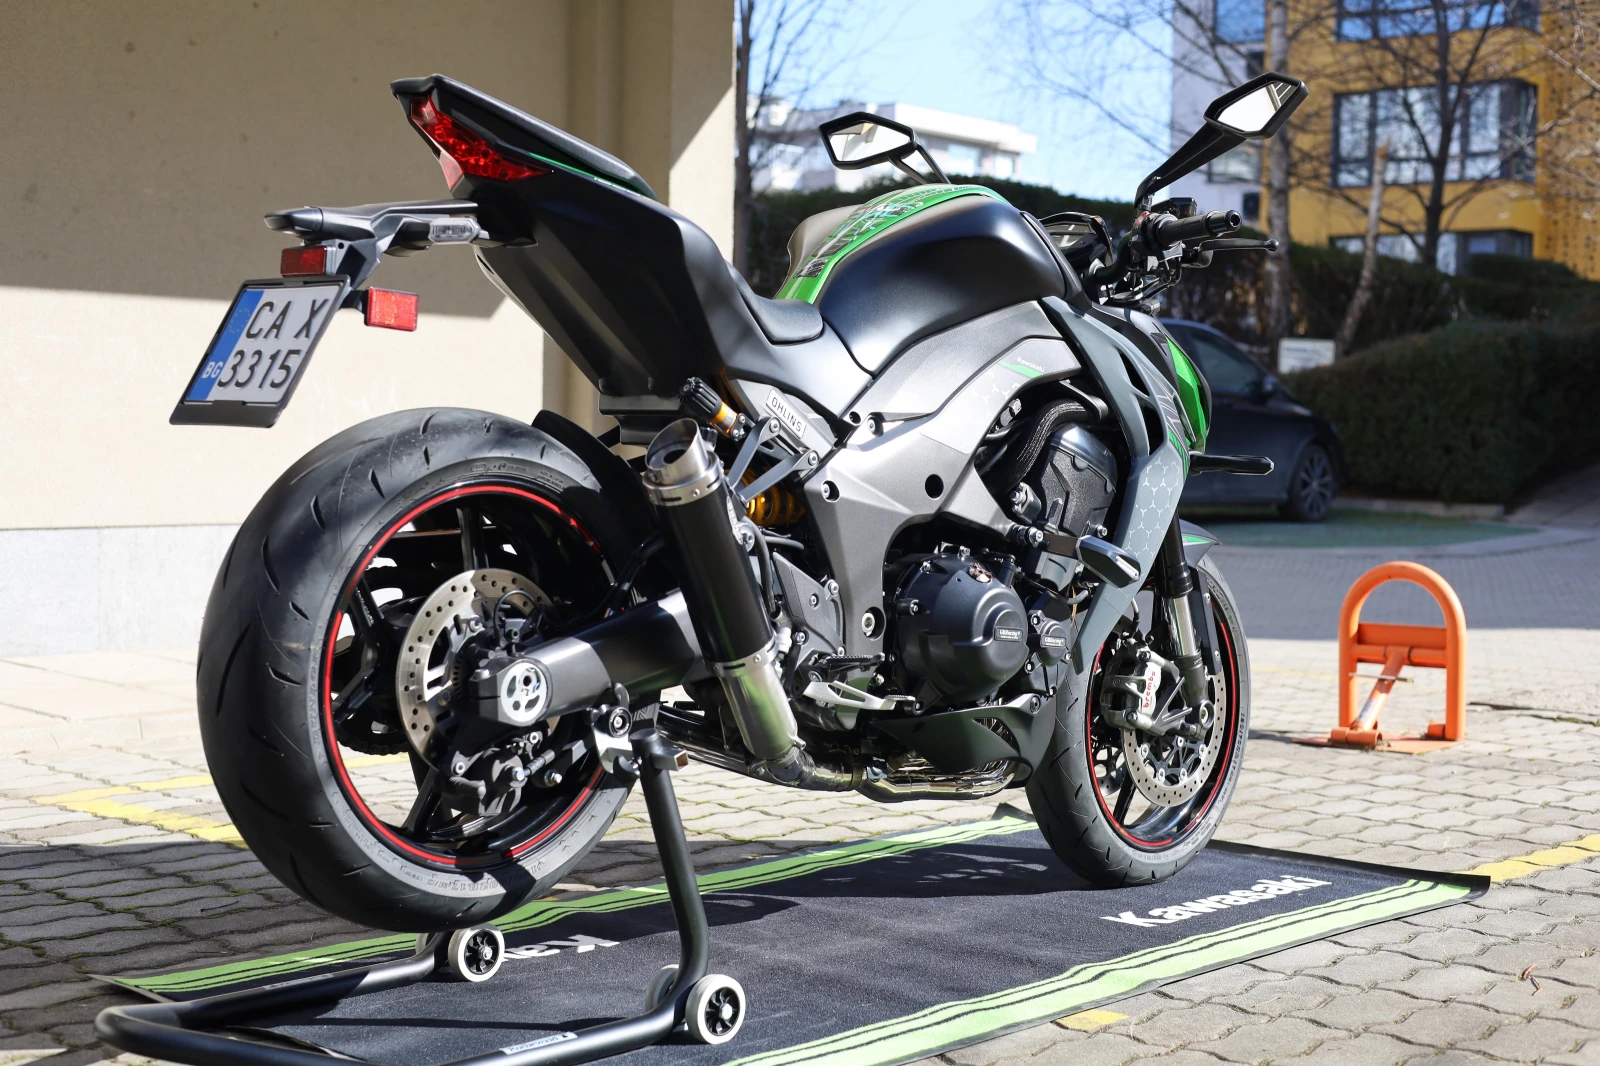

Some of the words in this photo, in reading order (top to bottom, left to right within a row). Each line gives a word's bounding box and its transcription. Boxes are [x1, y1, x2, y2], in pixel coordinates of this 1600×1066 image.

[246, 300, 292, 340] CA
[293, 299, 330, 340] X
[202, 361, 224, 379] BG
[217, 349, 302, 389] 3315
[1143, 671, 1156, 708] brembo
[1100, 875, 1332, 928] Kawasaki
